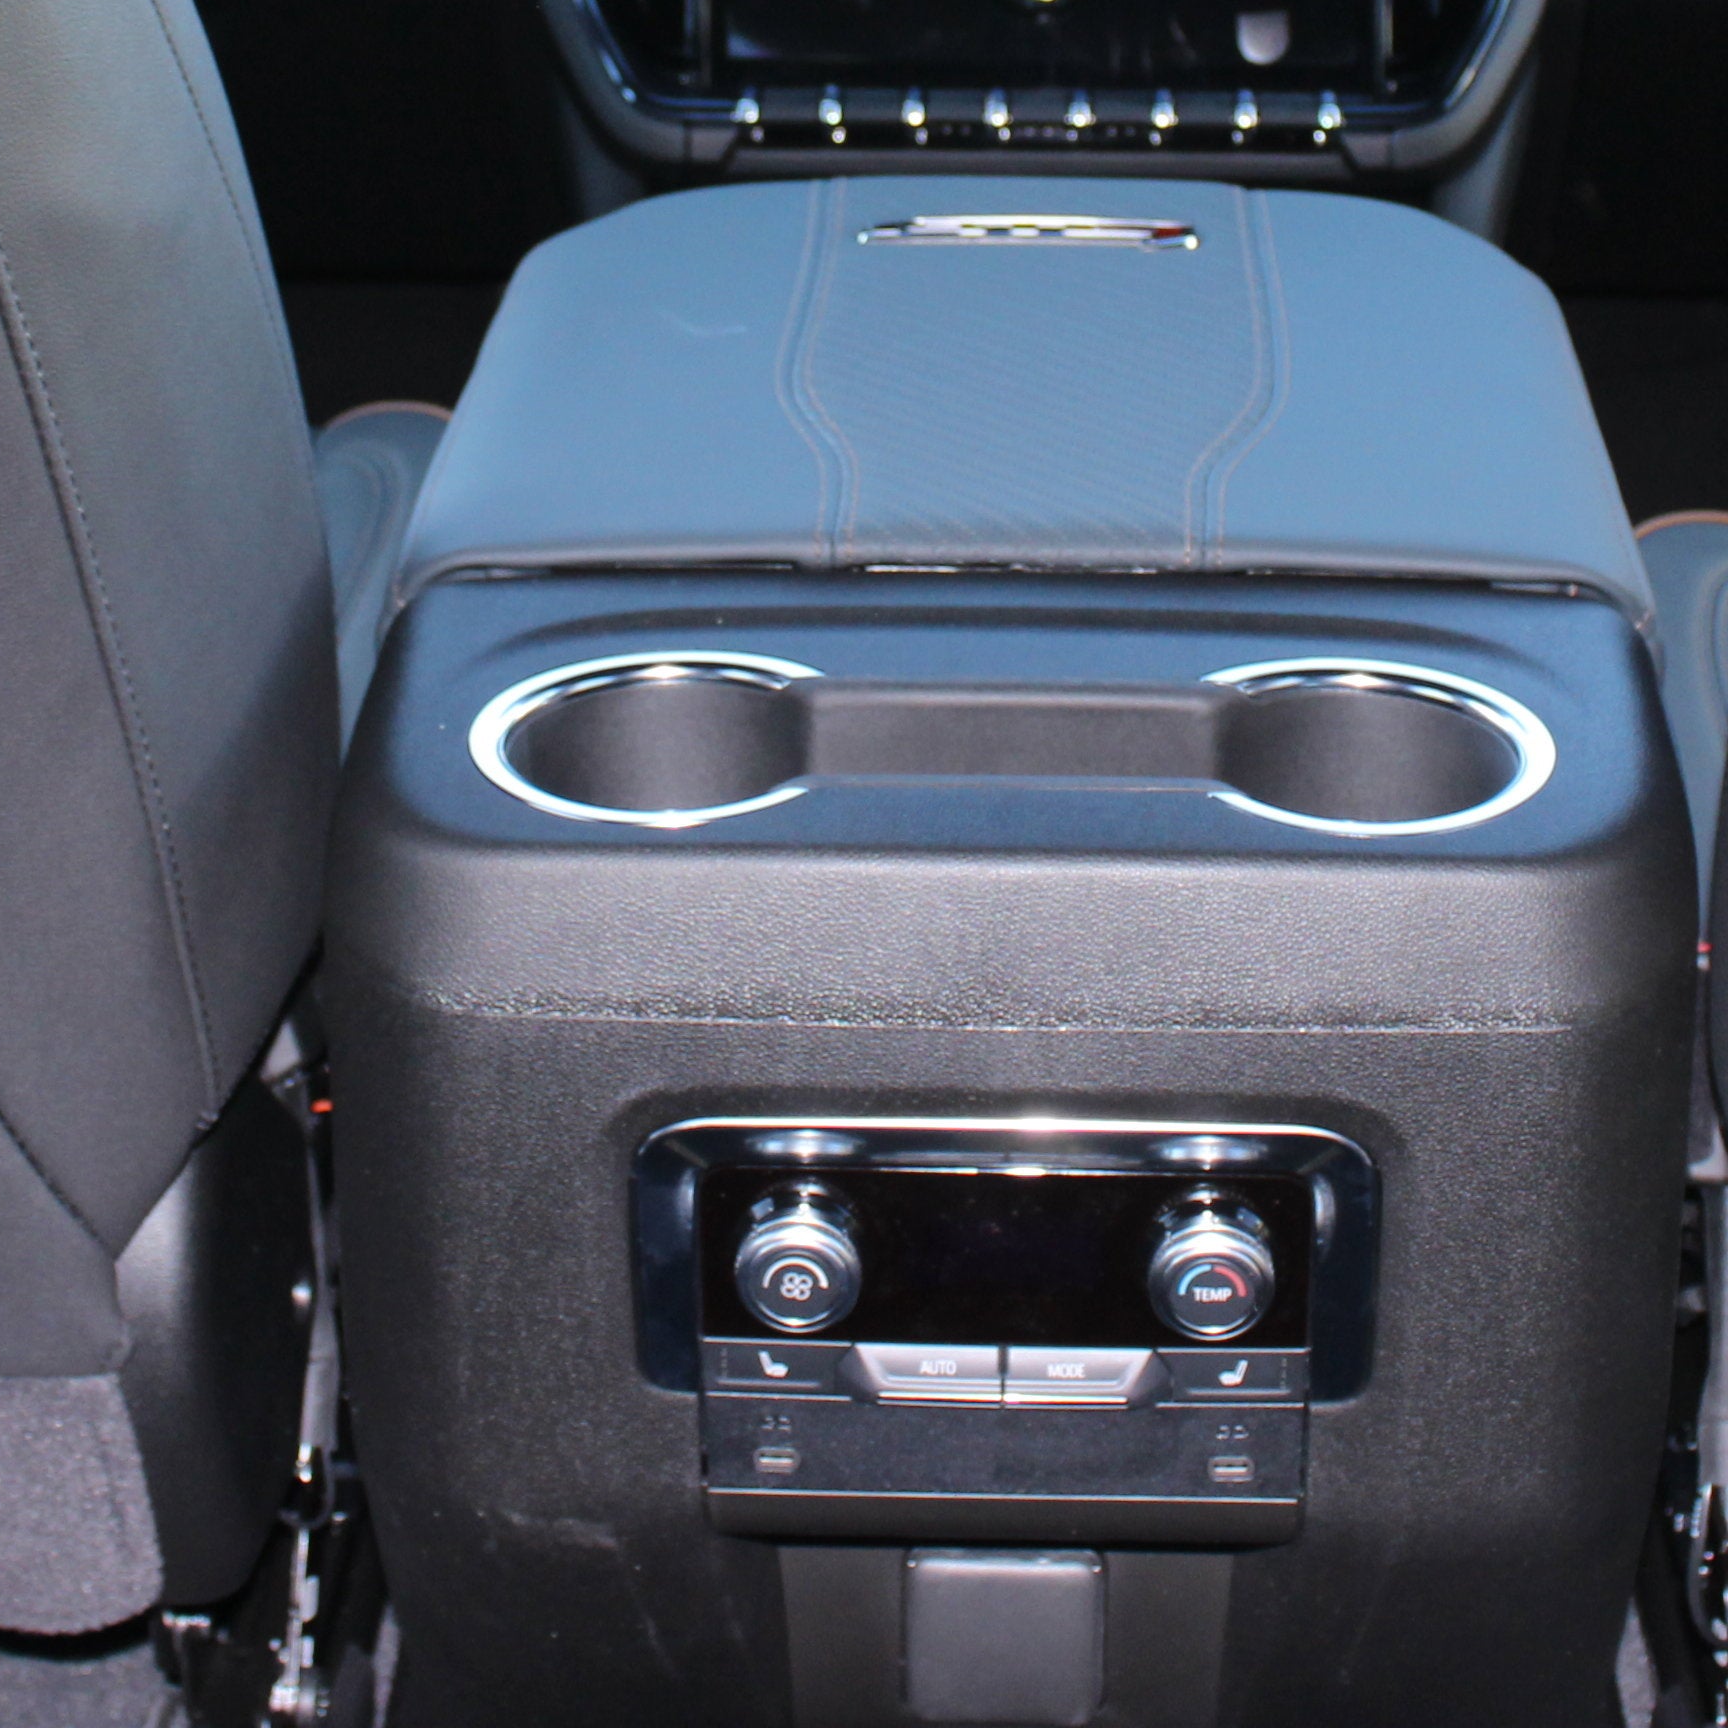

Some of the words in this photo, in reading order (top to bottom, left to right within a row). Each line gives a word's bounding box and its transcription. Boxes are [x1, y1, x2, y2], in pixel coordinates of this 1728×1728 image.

[1193, 1285, 1233, 1303] TEMP
[920, 1359, 958, 1376] AUTO
[1046, 1362, 1087, 1379] MODE
